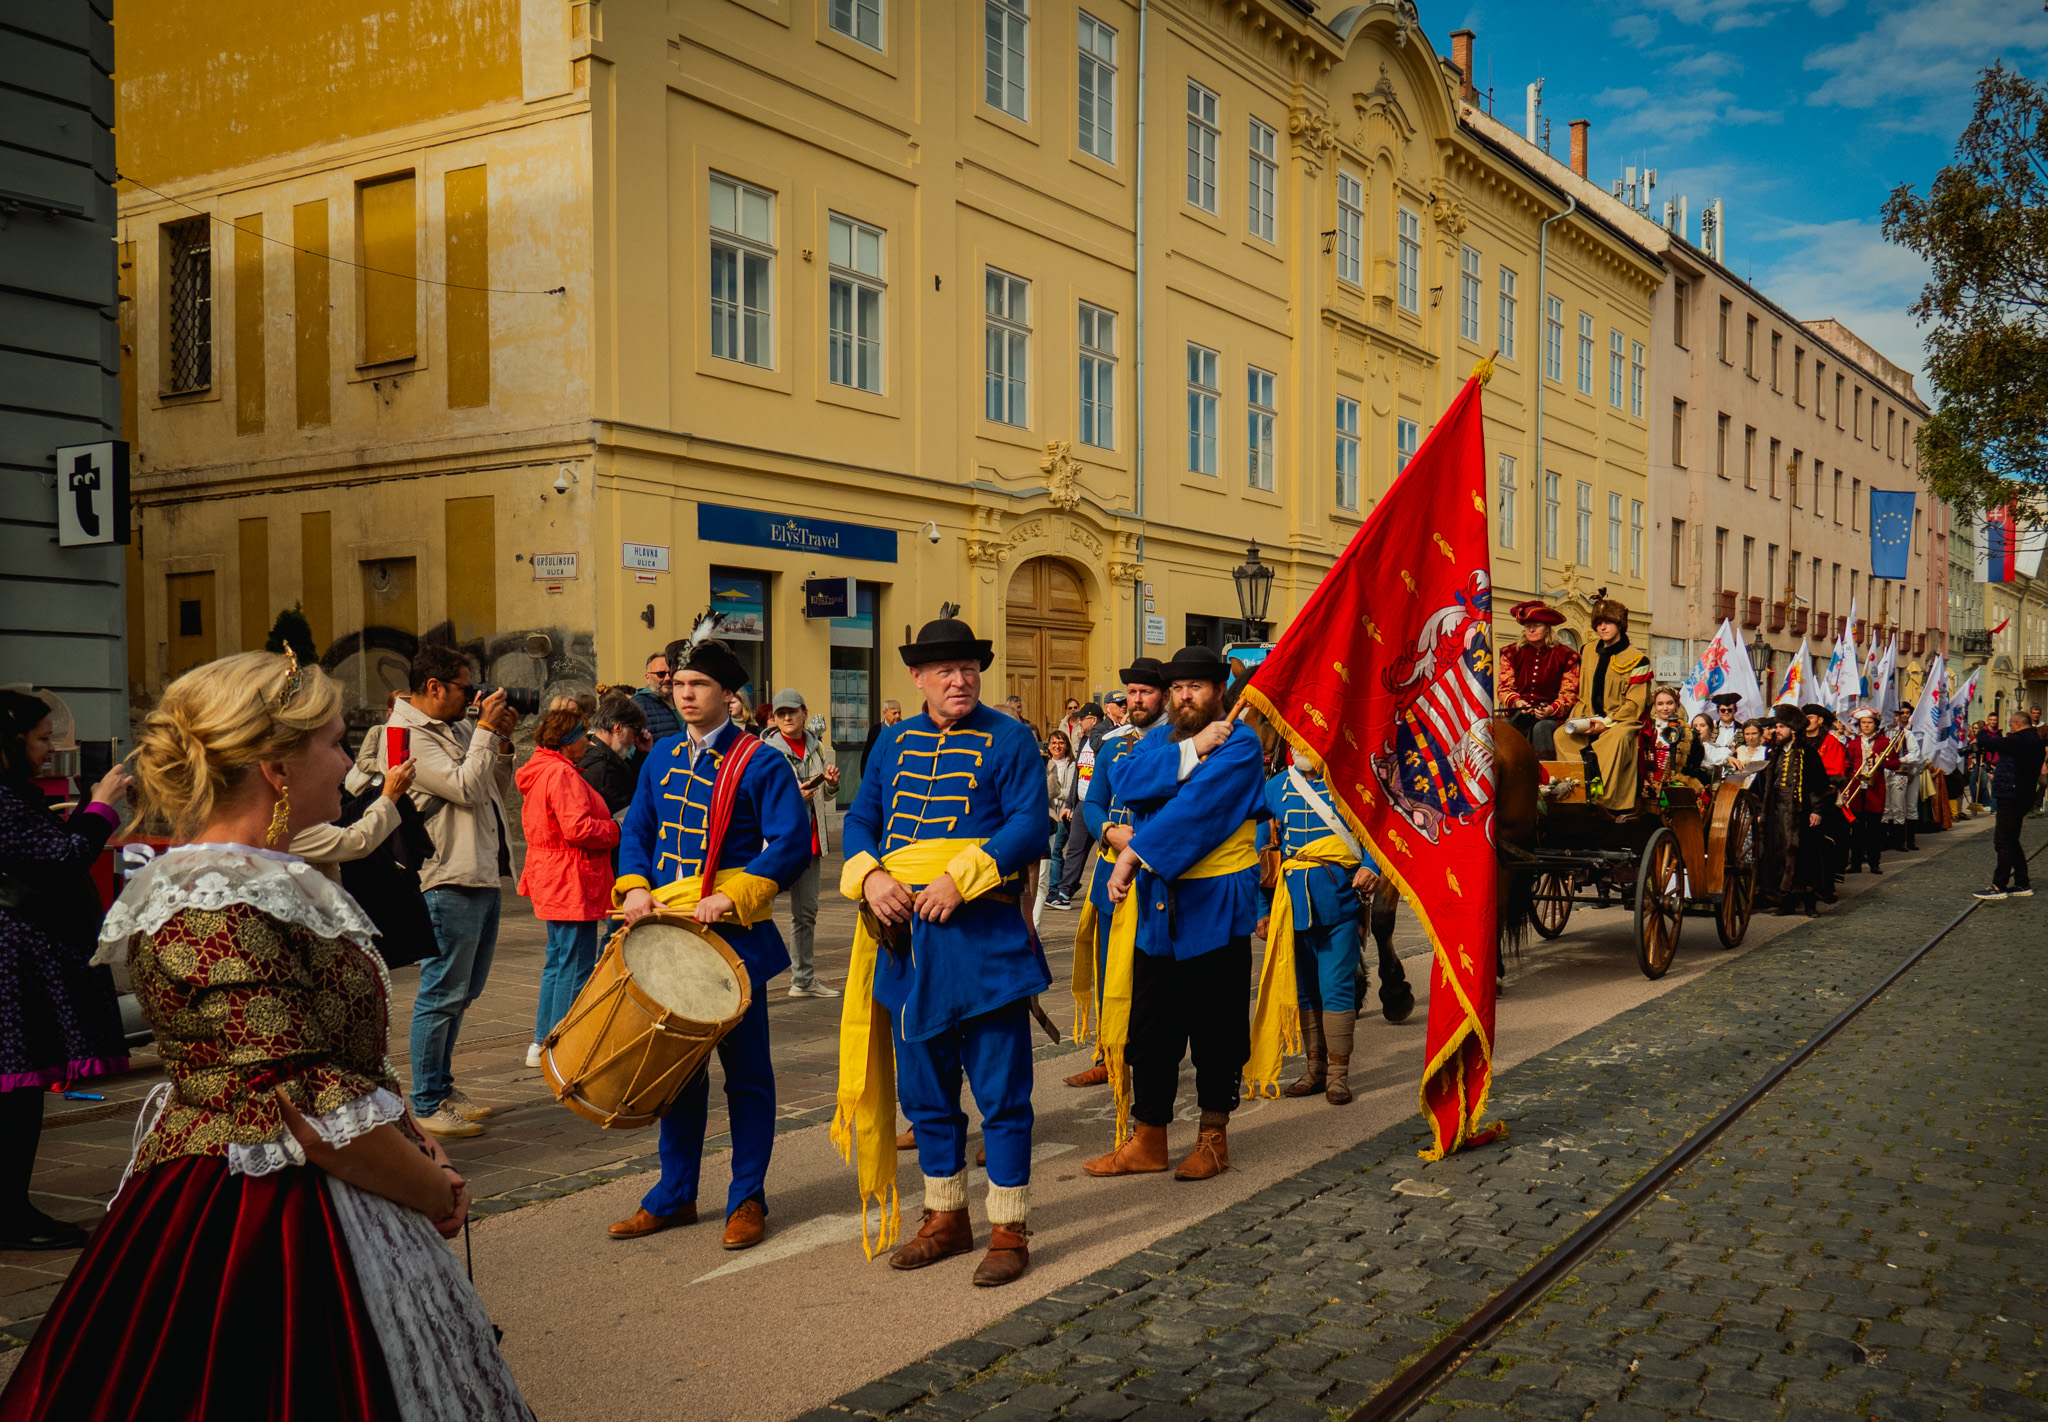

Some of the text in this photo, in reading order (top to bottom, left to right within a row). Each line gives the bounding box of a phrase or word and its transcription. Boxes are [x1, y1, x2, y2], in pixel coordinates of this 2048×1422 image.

[770, 524, 839, 549] ElysTravel
[634, 546, 658, 558] HLAVNÁ
[536, 555, 575, 566] URŠULÍNSKA
[637, 559, 656, 567] ULICA
